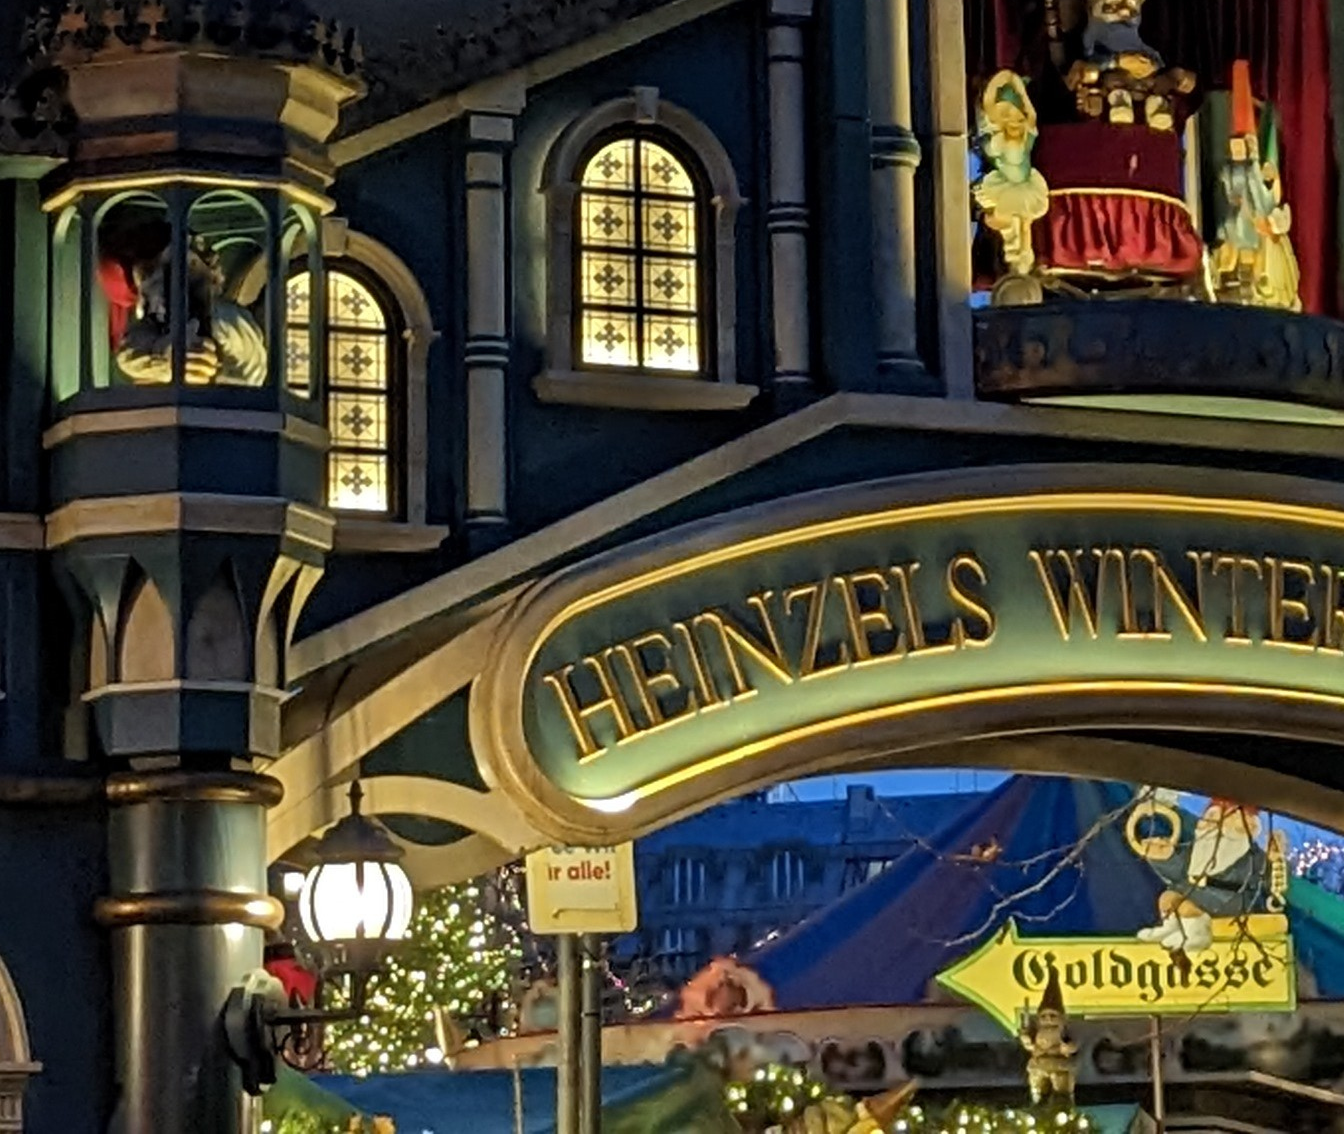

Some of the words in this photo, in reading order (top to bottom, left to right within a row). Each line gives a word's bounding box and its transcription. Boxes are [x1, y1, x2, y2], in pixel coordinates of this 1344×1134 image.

[543, 553, 998, 764] HEINZELS
[567, 860, 611, 880] alle!
[1012, 948, 1276, 1003] Goldgasse
